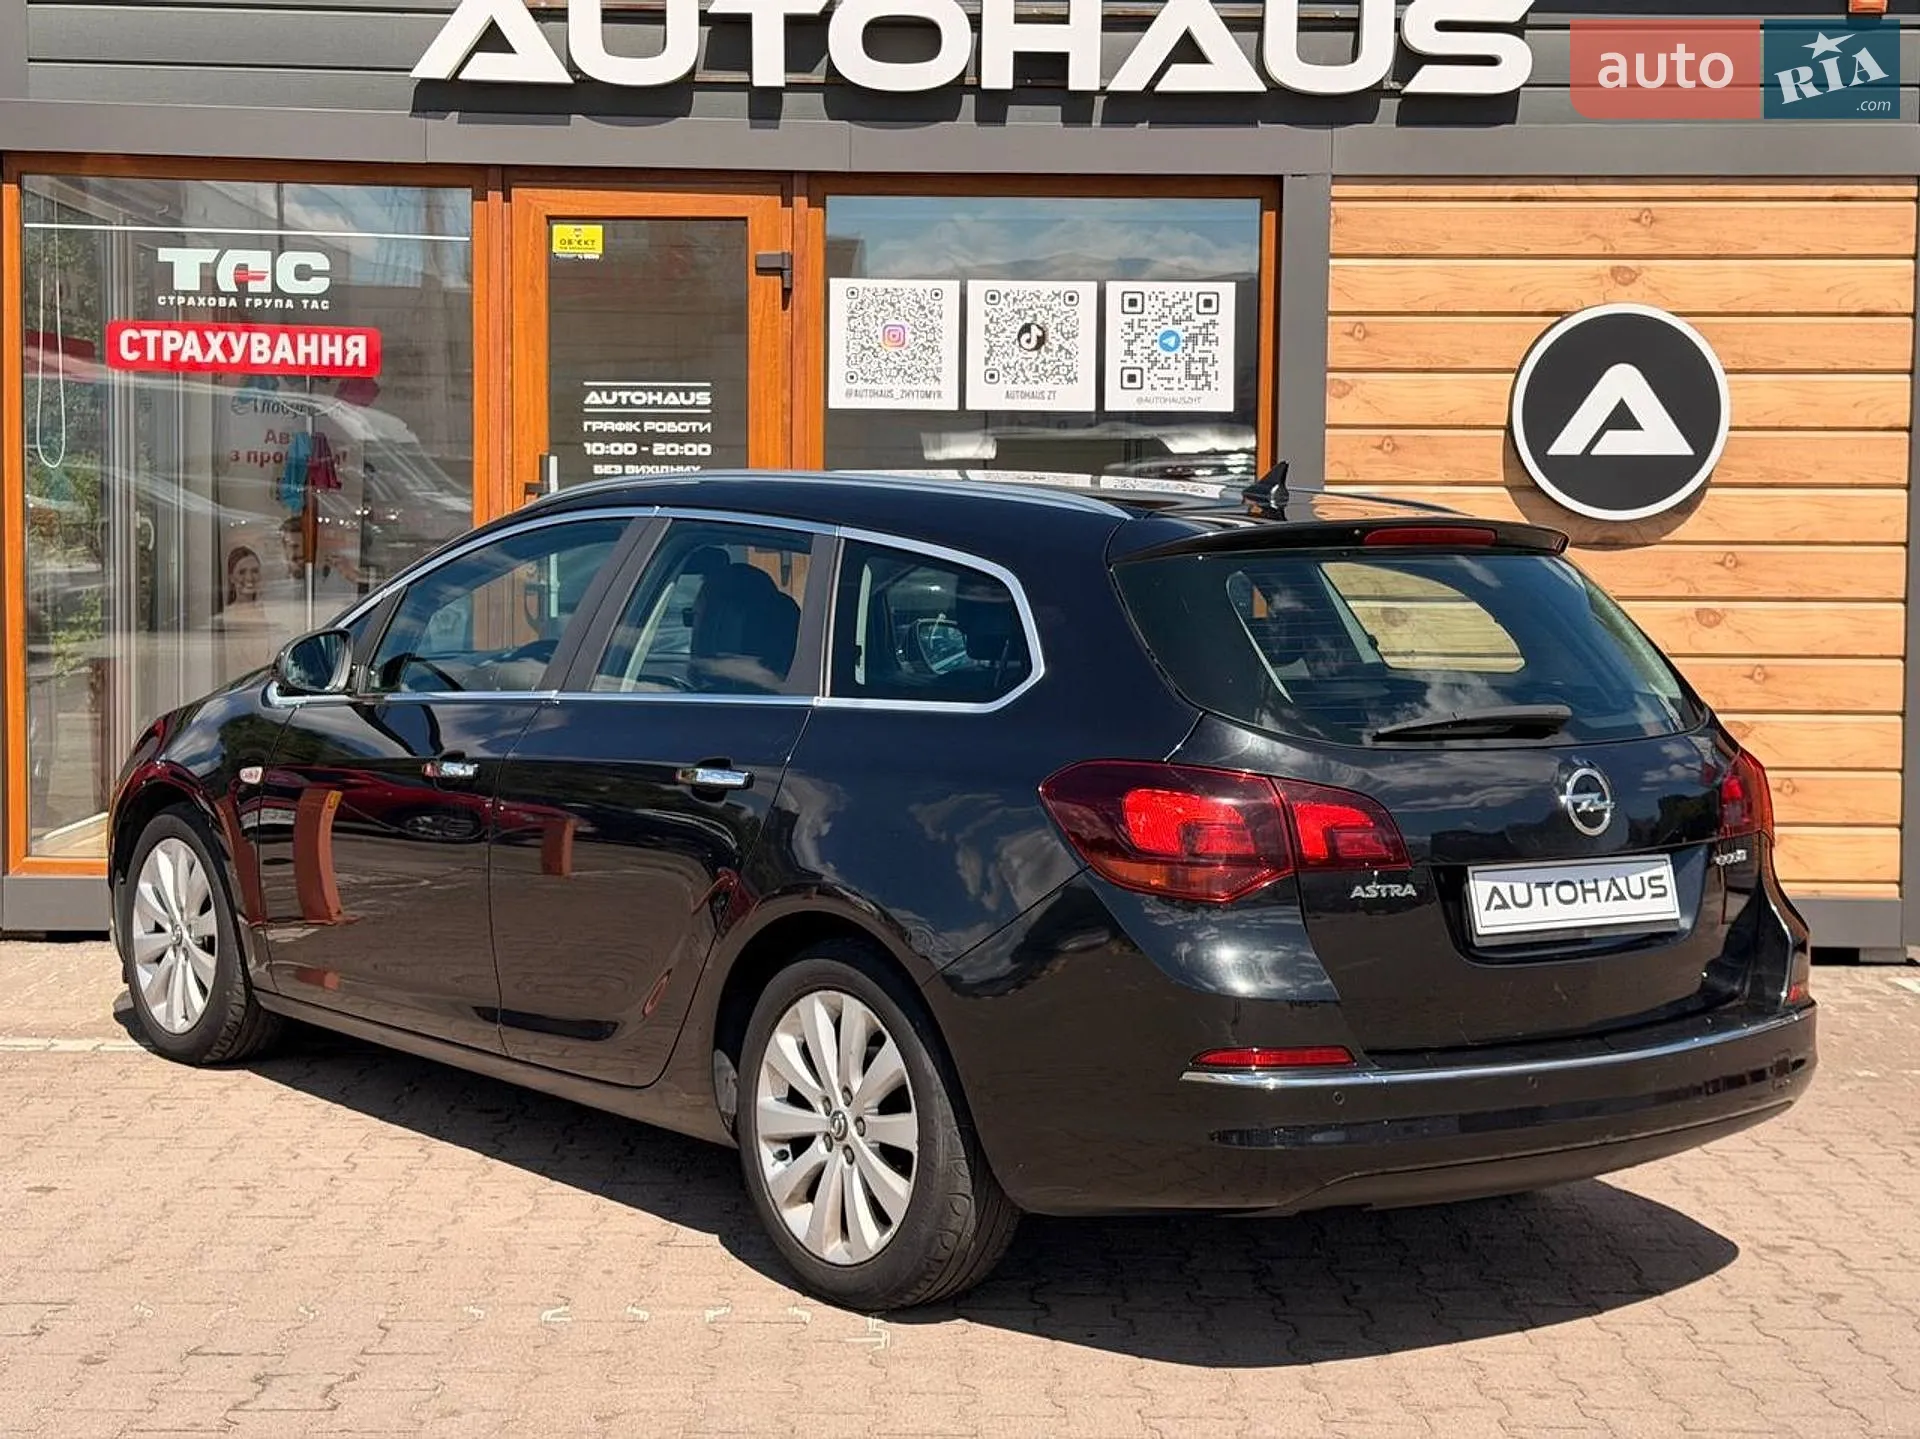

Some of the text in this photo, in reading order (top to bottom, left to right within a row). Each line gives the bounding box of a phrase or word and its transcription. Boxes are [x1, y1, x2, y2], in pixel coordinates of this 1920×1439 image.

[411, 0, 1537, 95] AUTOHAUS
[157, 247, 331, 295] ТАС
[157, 295, 330, 311] СТРАХОВА ГРУПА ТАС
[119, 328, 367, 367] СТРАХУВАННЯ
[583, 390, 712, 405] AUTOHAUS
[1004, 389, 1056, 401] AUTOHAUS ZT
[583, 421, 712, 433] ГРАФІК РОБОТИ
[584, 442, 638, 455] 10:00
[652, 443, 712, 456] 20:00
[593, 464, 623, 475] БЕЗ
[1350, 883, 1417, 899] ASTRA
[1484, 874, 1669, 911] AUTOHAUS
